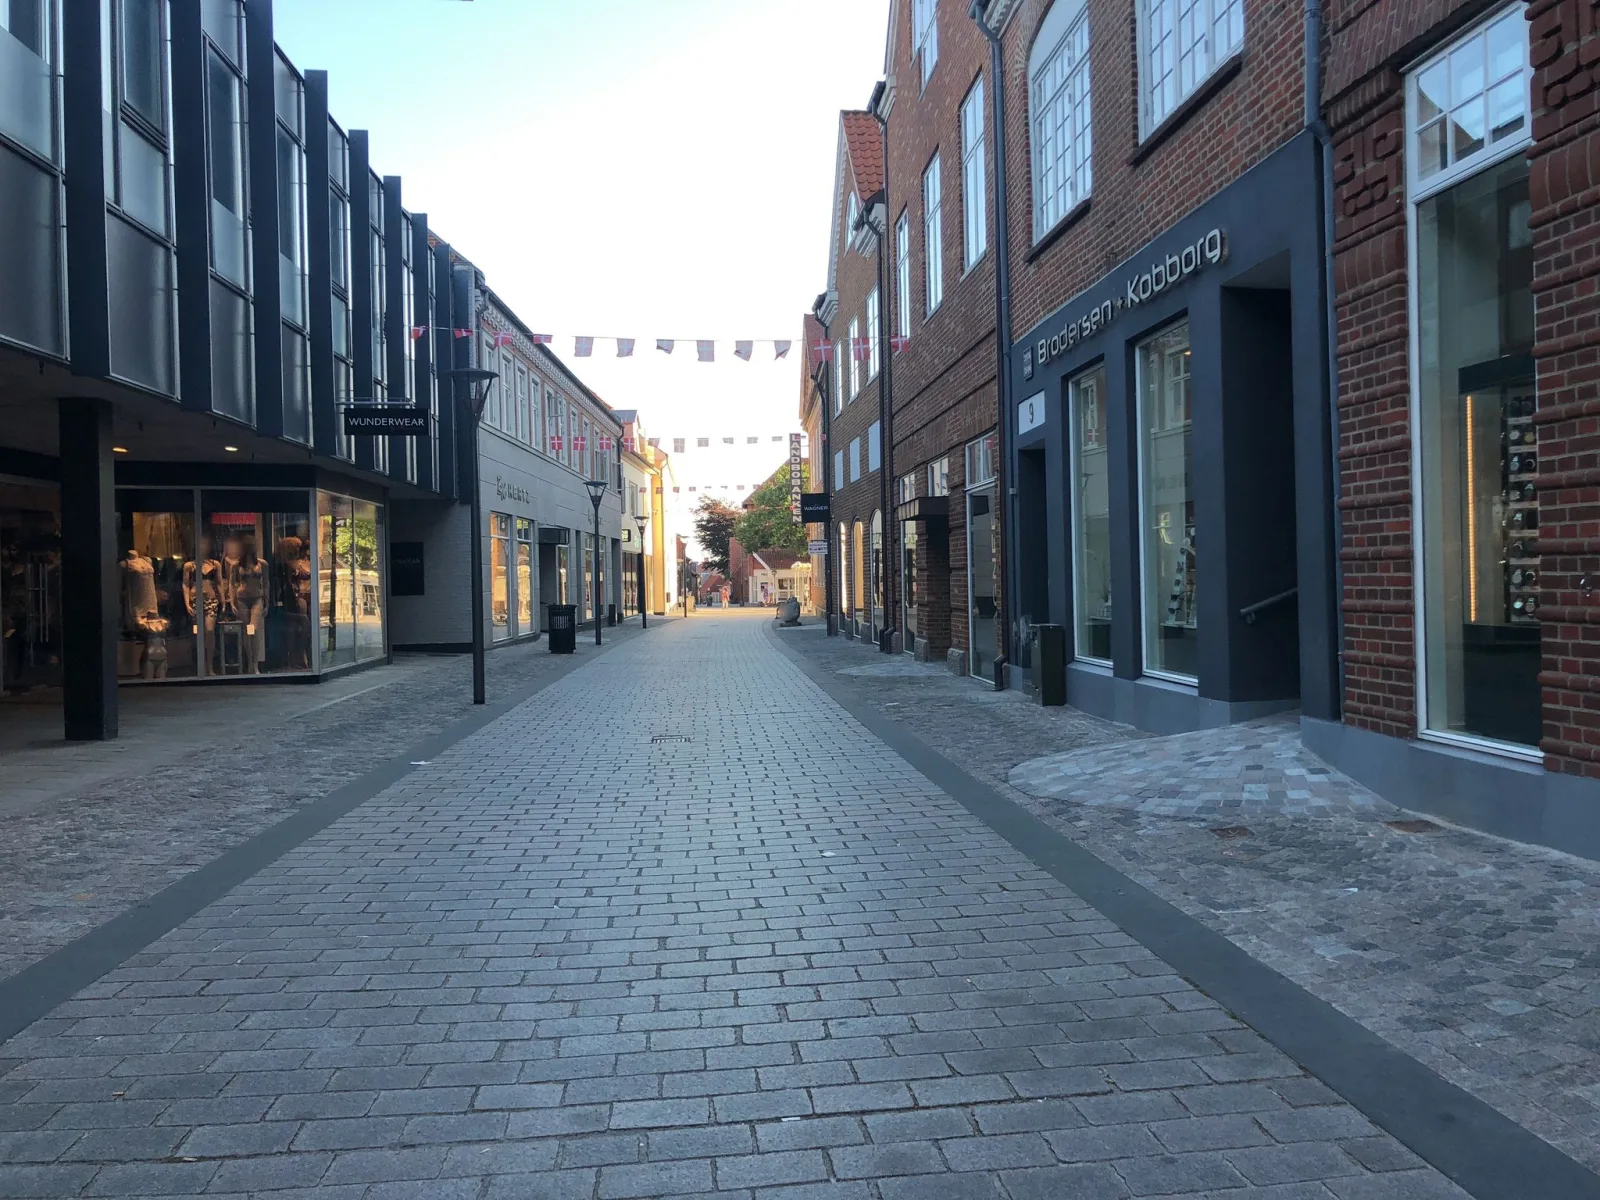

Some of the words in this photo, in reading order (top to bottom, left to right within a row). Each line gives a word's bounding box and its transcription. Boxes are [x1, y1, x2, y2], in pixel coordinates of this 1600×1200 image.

[1037, 299, 1112, 364] Brodersen
[1127, 228, 1224, 309] Kobborg
[348, 417, 425, 427] WUNDERWEAR
[1028, 402, 1035, 424] 9
[790, 434, 802, 523] LANDBOBANKEN
